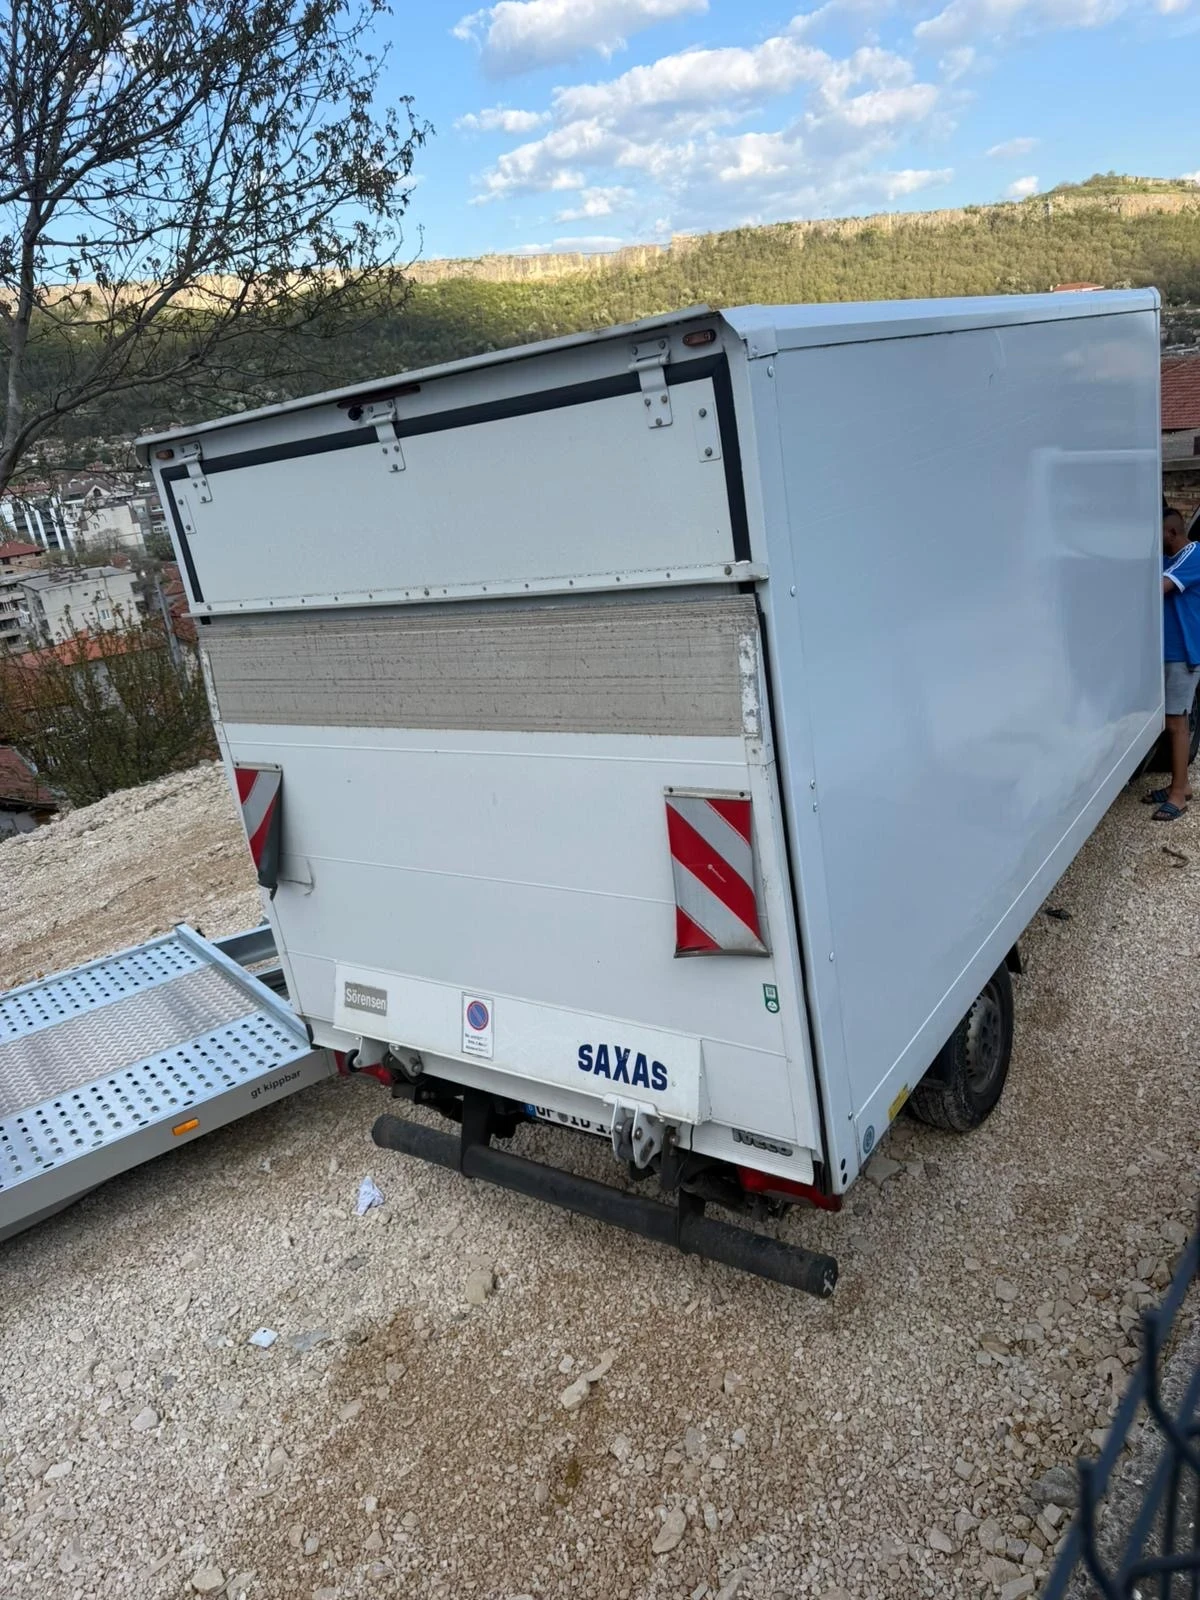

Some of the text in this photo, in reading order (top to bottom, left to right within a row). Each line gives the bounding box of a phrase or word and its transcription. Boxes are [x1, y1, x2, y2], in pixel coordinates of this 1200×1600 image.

[346, 988, 386, 1010] Sörensen
[578, 1043, 668, 1091] SAXAS
[250, 1070, 301, 1099] gt kippbar
